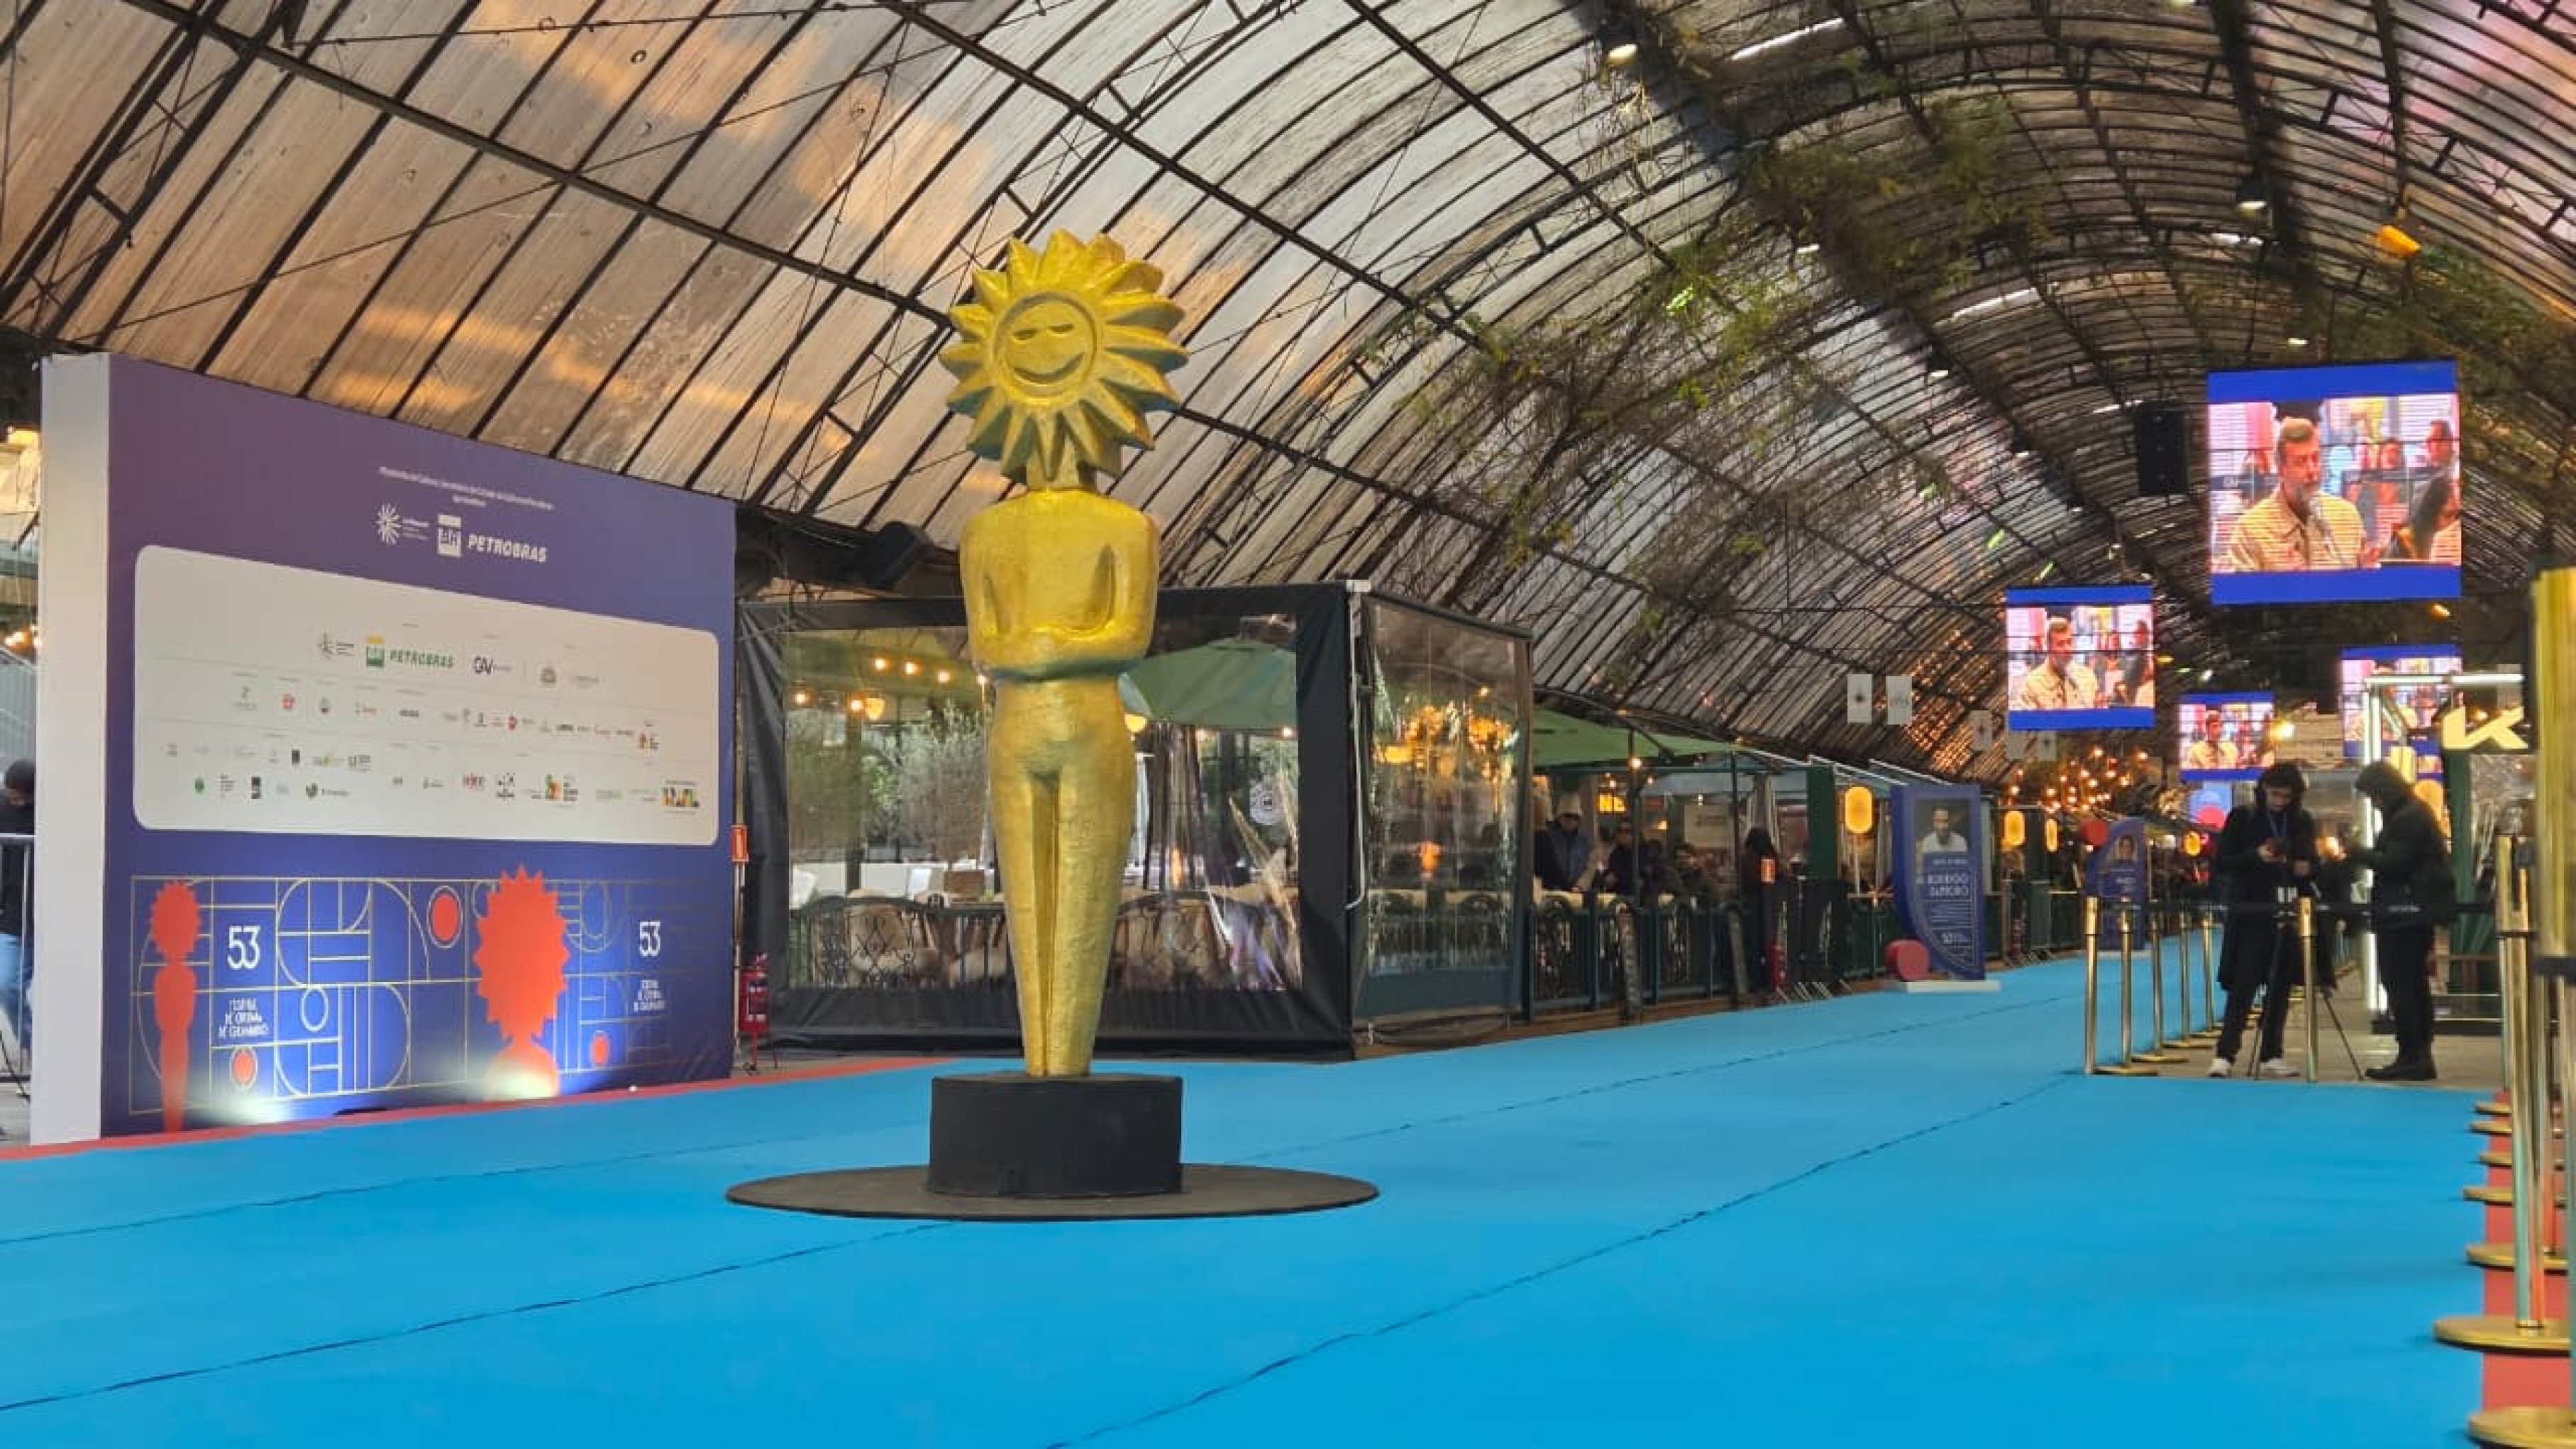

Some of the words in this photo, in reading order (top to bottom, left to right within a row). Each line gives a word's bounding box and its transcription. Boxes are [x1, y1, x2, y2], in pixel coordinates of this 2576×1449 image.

[468, 533, 548, 563] PETROBRAS
[227, 925, 261, 970] 53
[639, 921, 660, 957] 53
